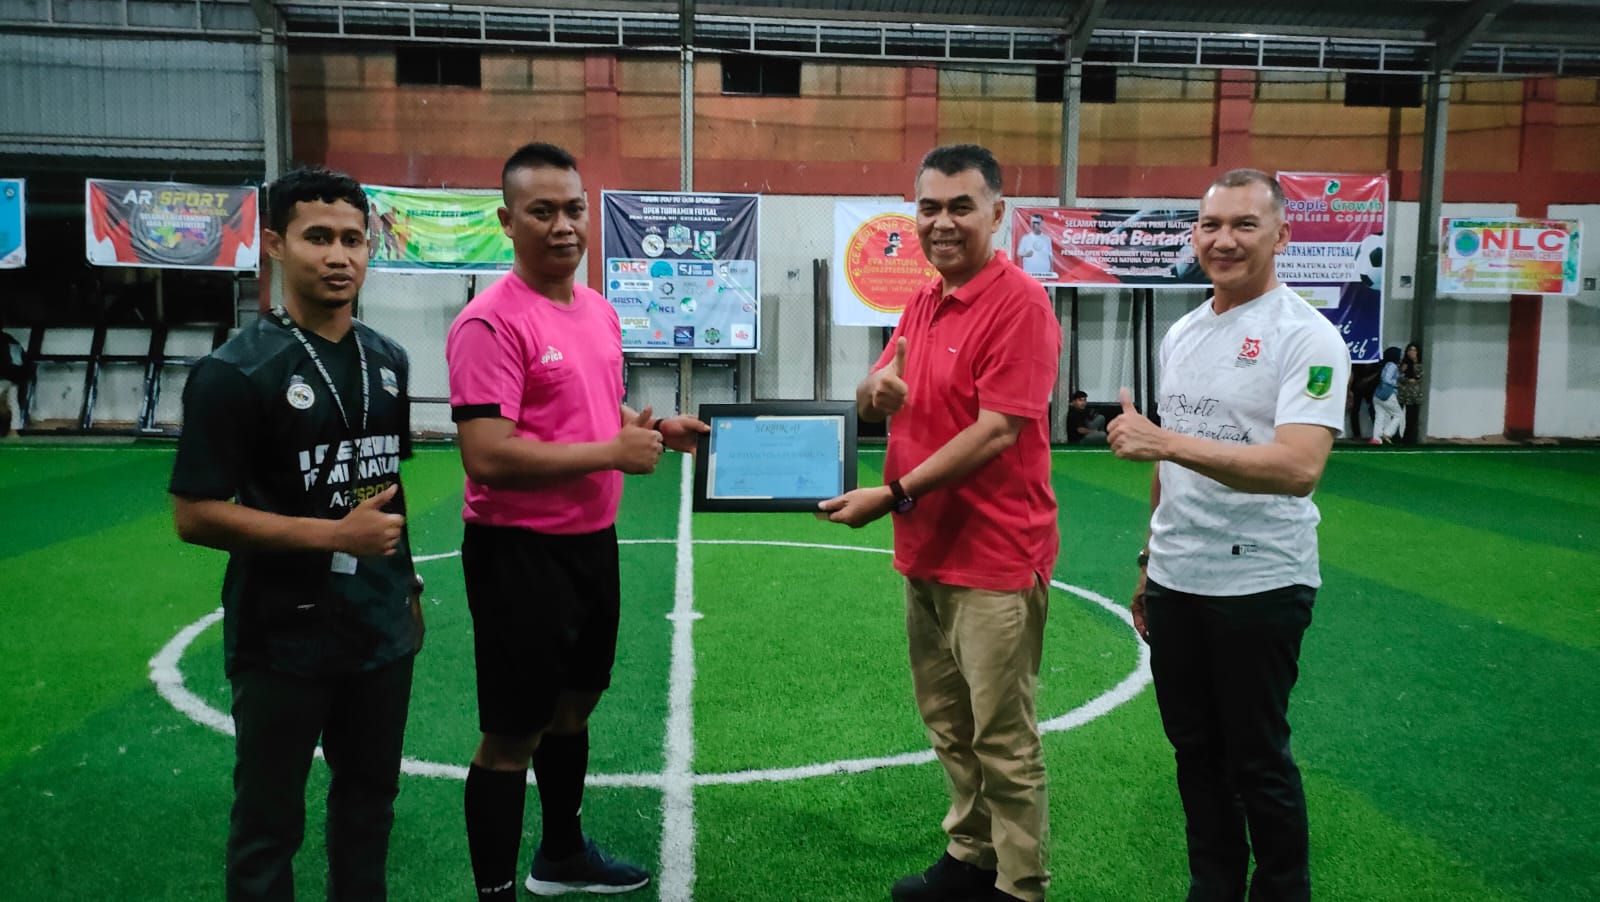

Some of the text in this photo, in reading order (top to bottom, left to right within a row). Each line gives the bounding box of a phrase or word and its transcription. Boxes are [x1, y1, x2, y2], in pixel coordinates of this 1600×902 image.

[122, 189, 230, 209] AR SPORT
[1331, 199, 1383, 213] Growth
[1065, 220, 1097, 228] SELAMAT
[1061, 229, 1128, 246] Selamat
[1481, 228, 1566, 252] NLC
[1327, 247, 1355, 257] FUTSAL
[620, 262, 647, 273] NLC
